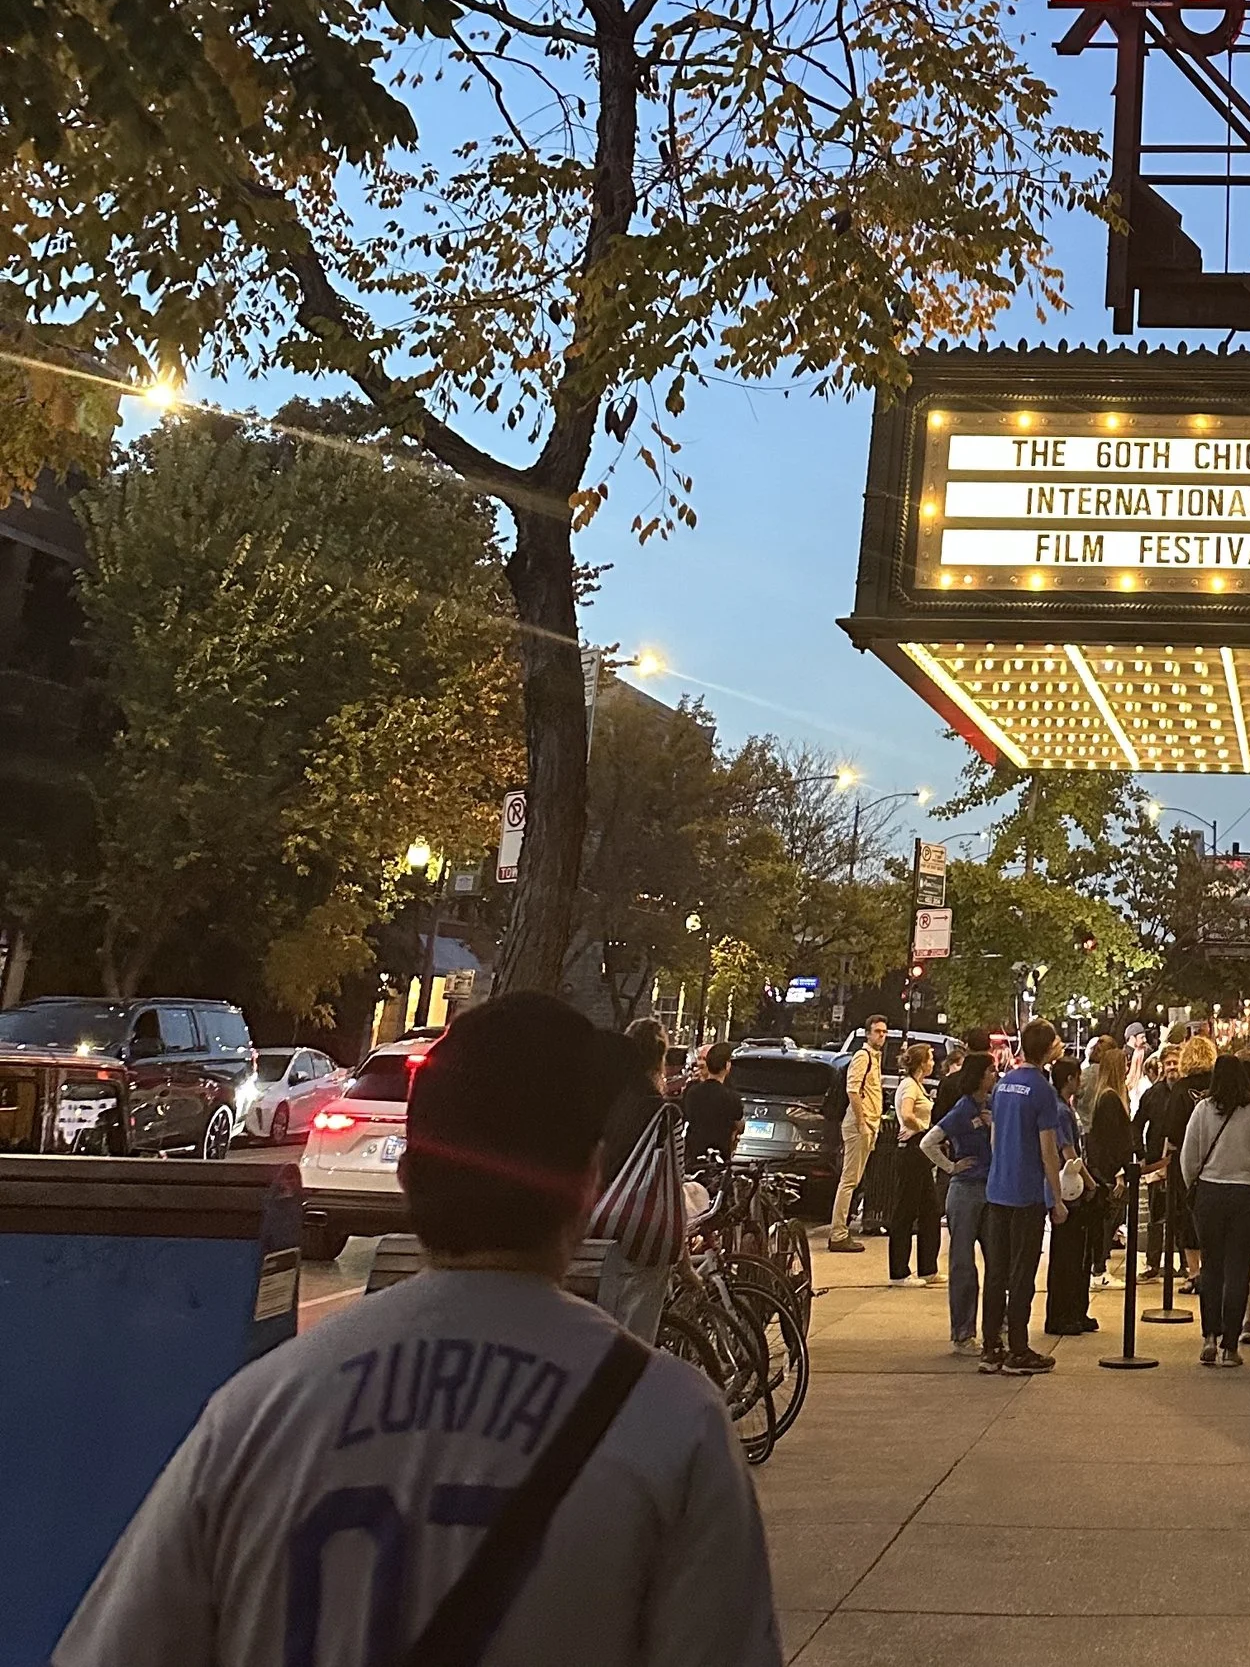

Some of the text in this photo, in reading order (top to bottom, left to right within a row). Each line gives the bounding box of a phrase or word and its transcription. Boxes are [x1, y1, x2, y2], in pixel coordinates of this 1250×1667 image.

[1012, 440, 1067, 467] THE
[1096, 441, 1170, 469] 60TH
[1036, 534, 1104, 563] FILM
[335, 1338, 568, 1456] ZURITA
